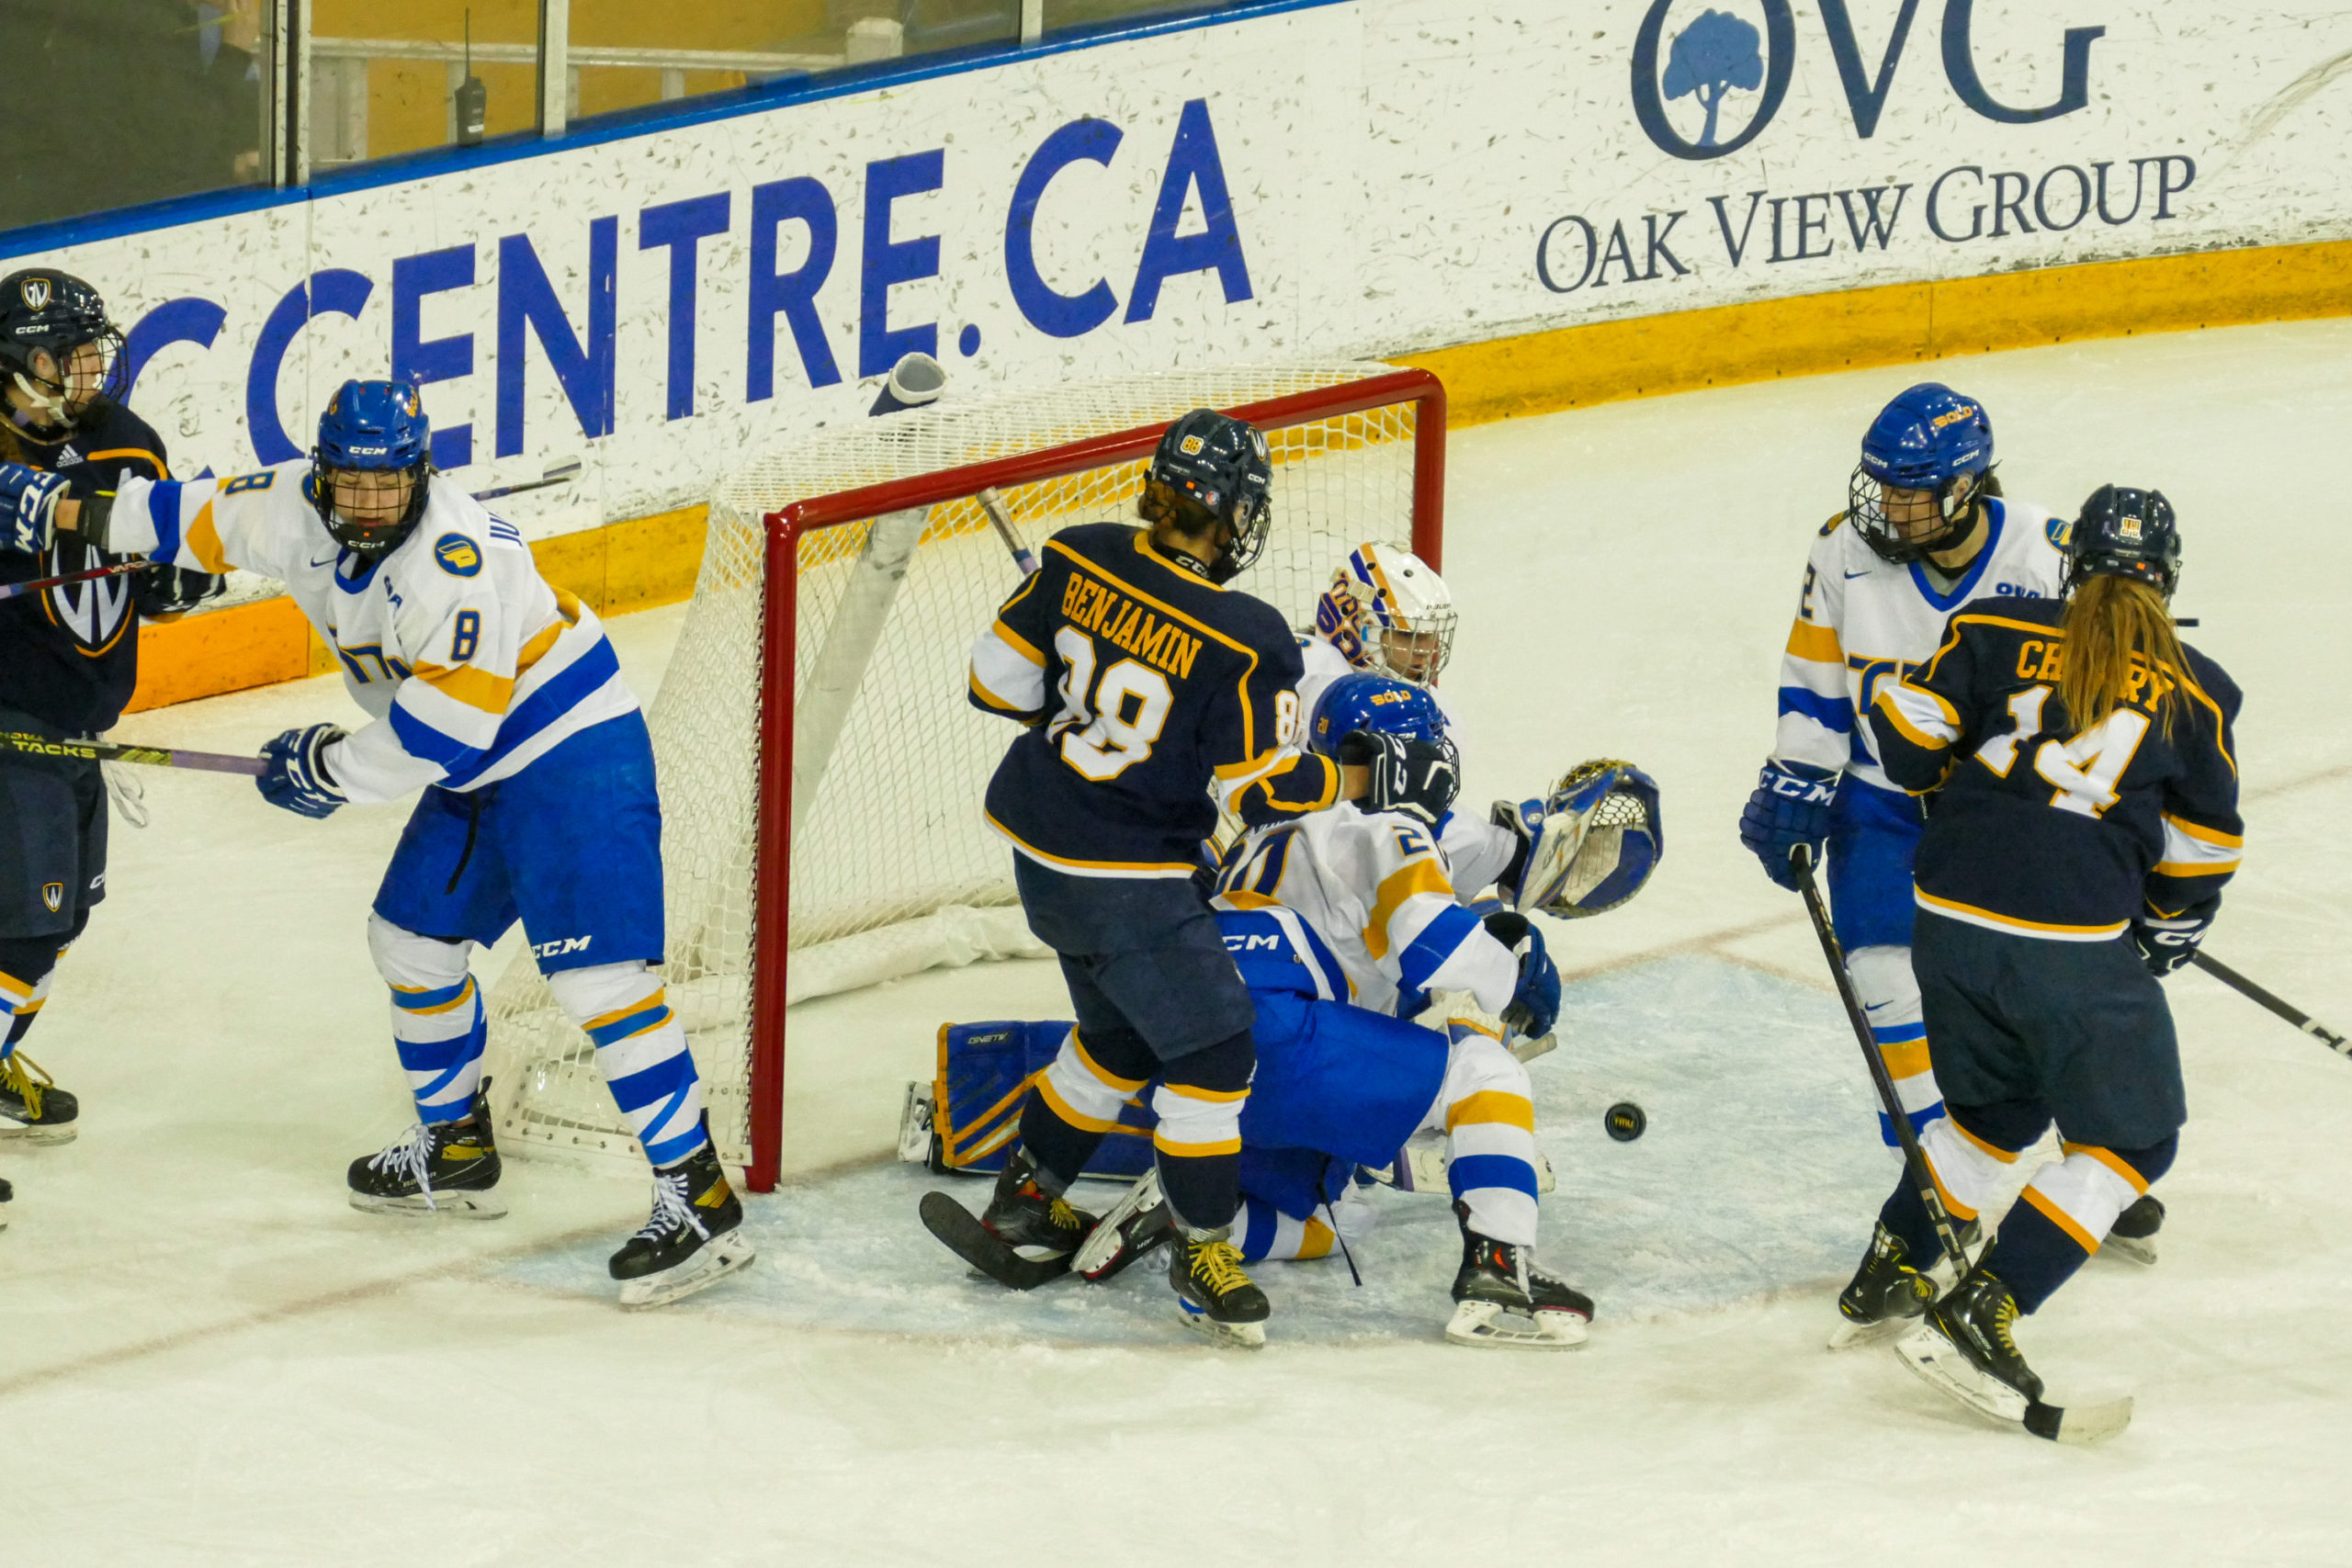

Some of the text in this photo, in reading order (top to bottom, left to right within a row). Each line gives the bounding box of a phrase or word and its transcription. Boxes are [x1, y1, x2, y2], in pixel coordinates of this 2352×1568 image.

[1630, 0, 2106, 160] OVG
[1535, 154, 2198, 295] OAK VIEW GROUP
[15, 324, 50, 334] CCM
[347, 446, 389, 456] CCM
[1181, 434, 1205, 456] 88
[55, 456, 85, 468] adidas
[1863, 451, 1889, 468] CCM
[1952, 448, 1980, 468] CCM
[1248, 473, 1266, 485] CCM
[347, 539, 386, 549] CCM
[448, 607, 482, 663] 8
[1061, 571, 1204, 680] BENJAMIN
[2016, 640, 2176, 713] CHRY
[12, 740, 96, 759] TACKS
[1974, 684, 2152, 819] 14
[1758, 769, 1838, 807] CCM
[531, 934, 593, 960] CCM
[1221, 934, 1280, 952] CM
